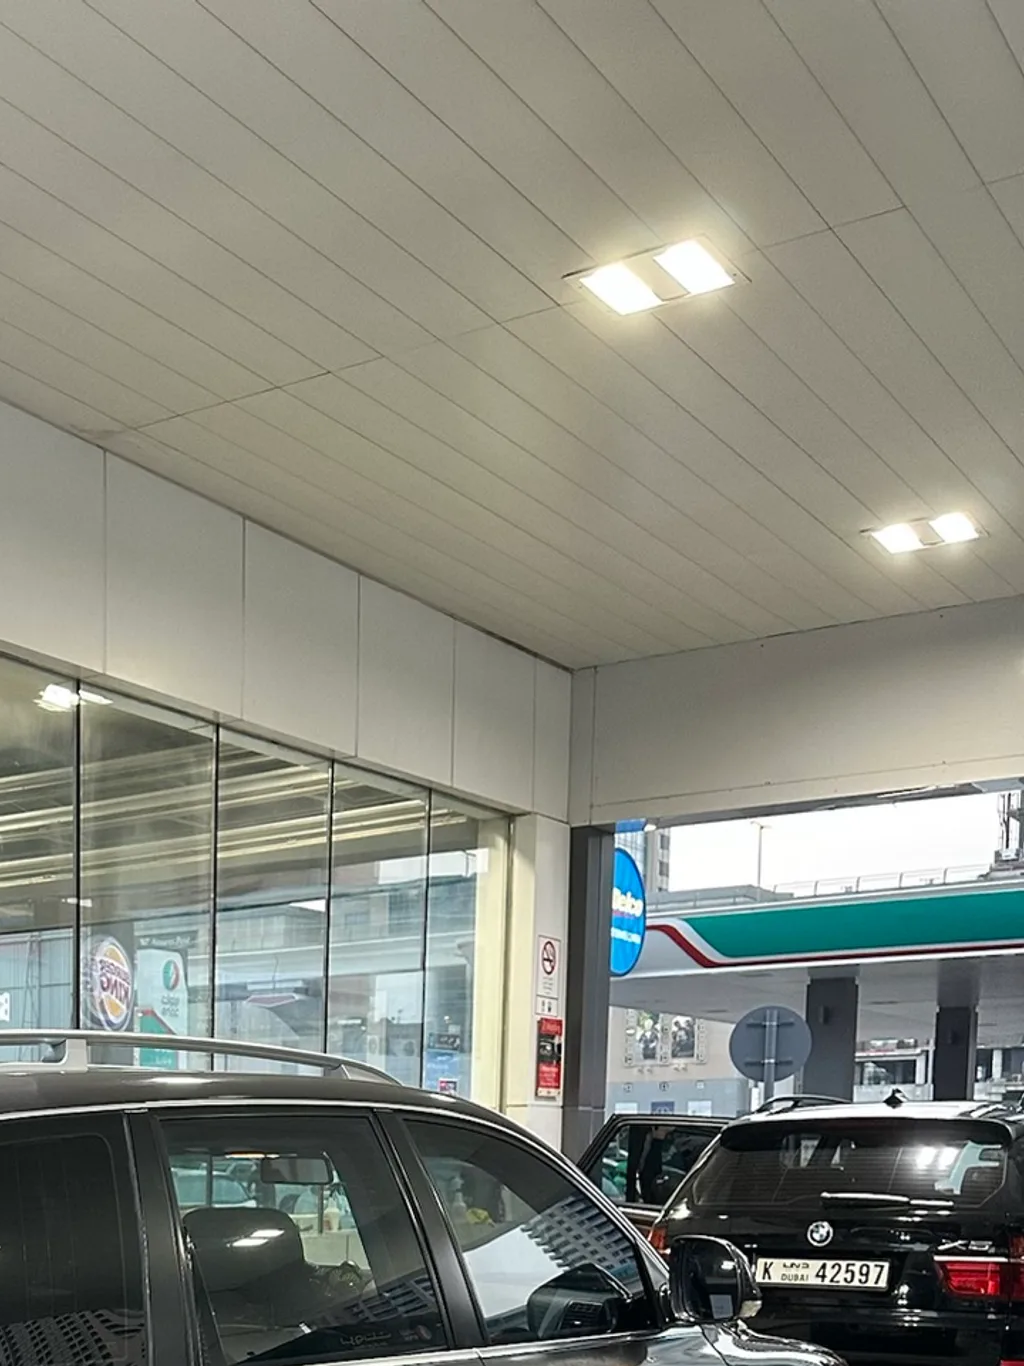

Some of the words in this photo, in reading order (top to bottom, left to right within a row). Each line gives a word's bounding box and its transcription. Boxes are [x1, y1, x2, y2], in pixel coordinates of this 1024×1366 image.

[761, 1261, 774, 1281] K
[781, 1273, 809, 1281] DUBAI
[815, 1262, 885, 1285] 42597
